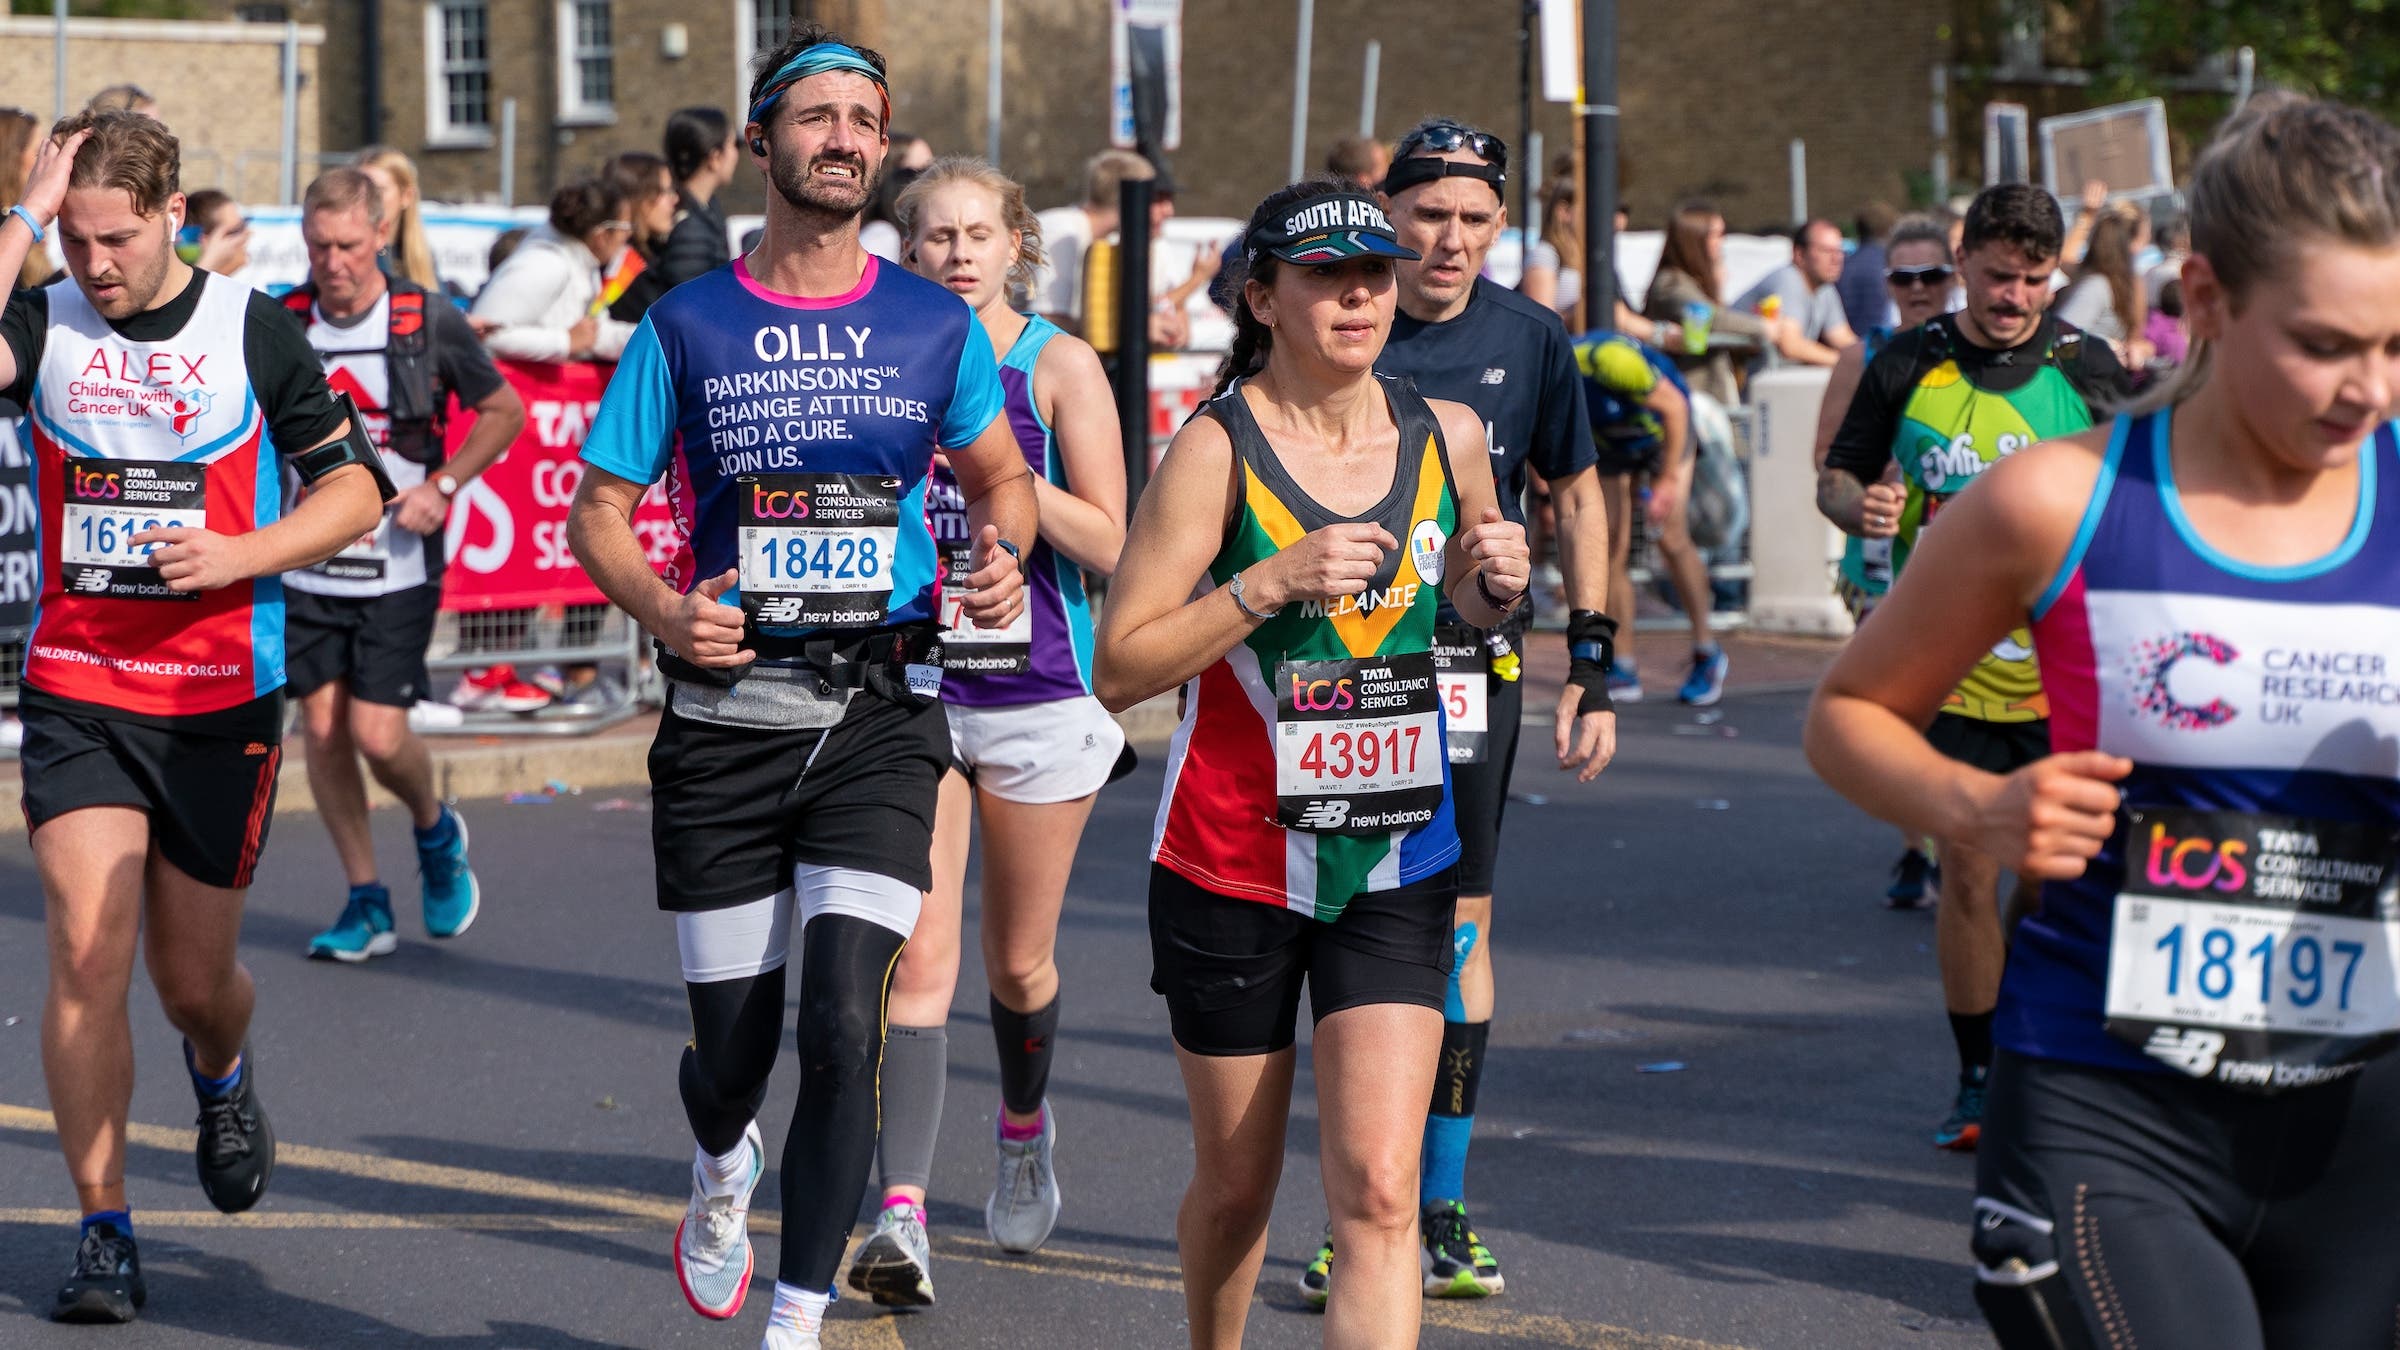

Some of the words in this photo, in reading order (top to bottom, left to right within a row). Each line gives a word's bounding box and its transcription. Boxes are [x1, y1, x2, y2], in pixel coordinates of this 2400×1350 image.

[1285, 200, 1343, 236] SOUTH
[1347, 199, 1395, 233] AFRI
[754, 323, 872, 362] OLLY
[82, 348, 208, 385] ALEX
[68, 381, 135, 399] Children
[139, 389, 173, 403] with
[704, 367, 882, 403] PARKINSON'S
[68, 399, 124, 415] Cancer
[128, 402, 152, 417] UK
[708, 397, 801, 429] CHANGE
[809, 396, 928, 423] ATTITUDES.
[711, 427, 760, 453] FIND
[764, 422, 781, 444] A
[784, 419, 853, 442] CURE.
[718, 449, 762, 476] JOIN
[766, 446, 804, 469] US.
[74, 465, 120, 499] tcs
[124, 467, 157, 479] TATA
[124, 479, 198, 492] CONSULTANCY
[124, 491, 171, 502] SERVICES
[754, 484, 809, 519] tcs
[815, 484, 849, 495] TATA
[815, 497, 887, 508] CONSULTANCY
[815, 508, 865, 520] SERVICES
[762, 537, 879, 579] 18428
[111, 582, 138, 595] new
[138, 583, 188, 596] bala
[1300, 583, 1418, 619] MELANIE
[803, 610, 831, 624] new
[833, 610, 880, 623] balance
[944, 656, 966, 669] new
[967, 656, 1017, 669] balance
[2263, 649, 2386, 677] CANCER
[1292, 673, 1354, 711] tcs
[1360, 667, 1393, 681] TATA
[1360, 677, 1430, 696] CONSULTANCY
[1360, 694, 1408, 709] SERVICES
[2259, 703, 2303, 724] UK
[1300, 726, 1421, 779] 43917
[1351, 814, 1379, 829] new
[1382, 809, 1431, 826] balance
[2145, 821, 2249, 894] tcs
[2257, 828, 2320, 853] TATA
[2254, 853, 2385, 887] CONSULTANCY
[2253, 876, 2343, 902] SERVICES
[2154, 922, 2367, 1011] 18197
[2218, 1059, 2274, 1083] new
